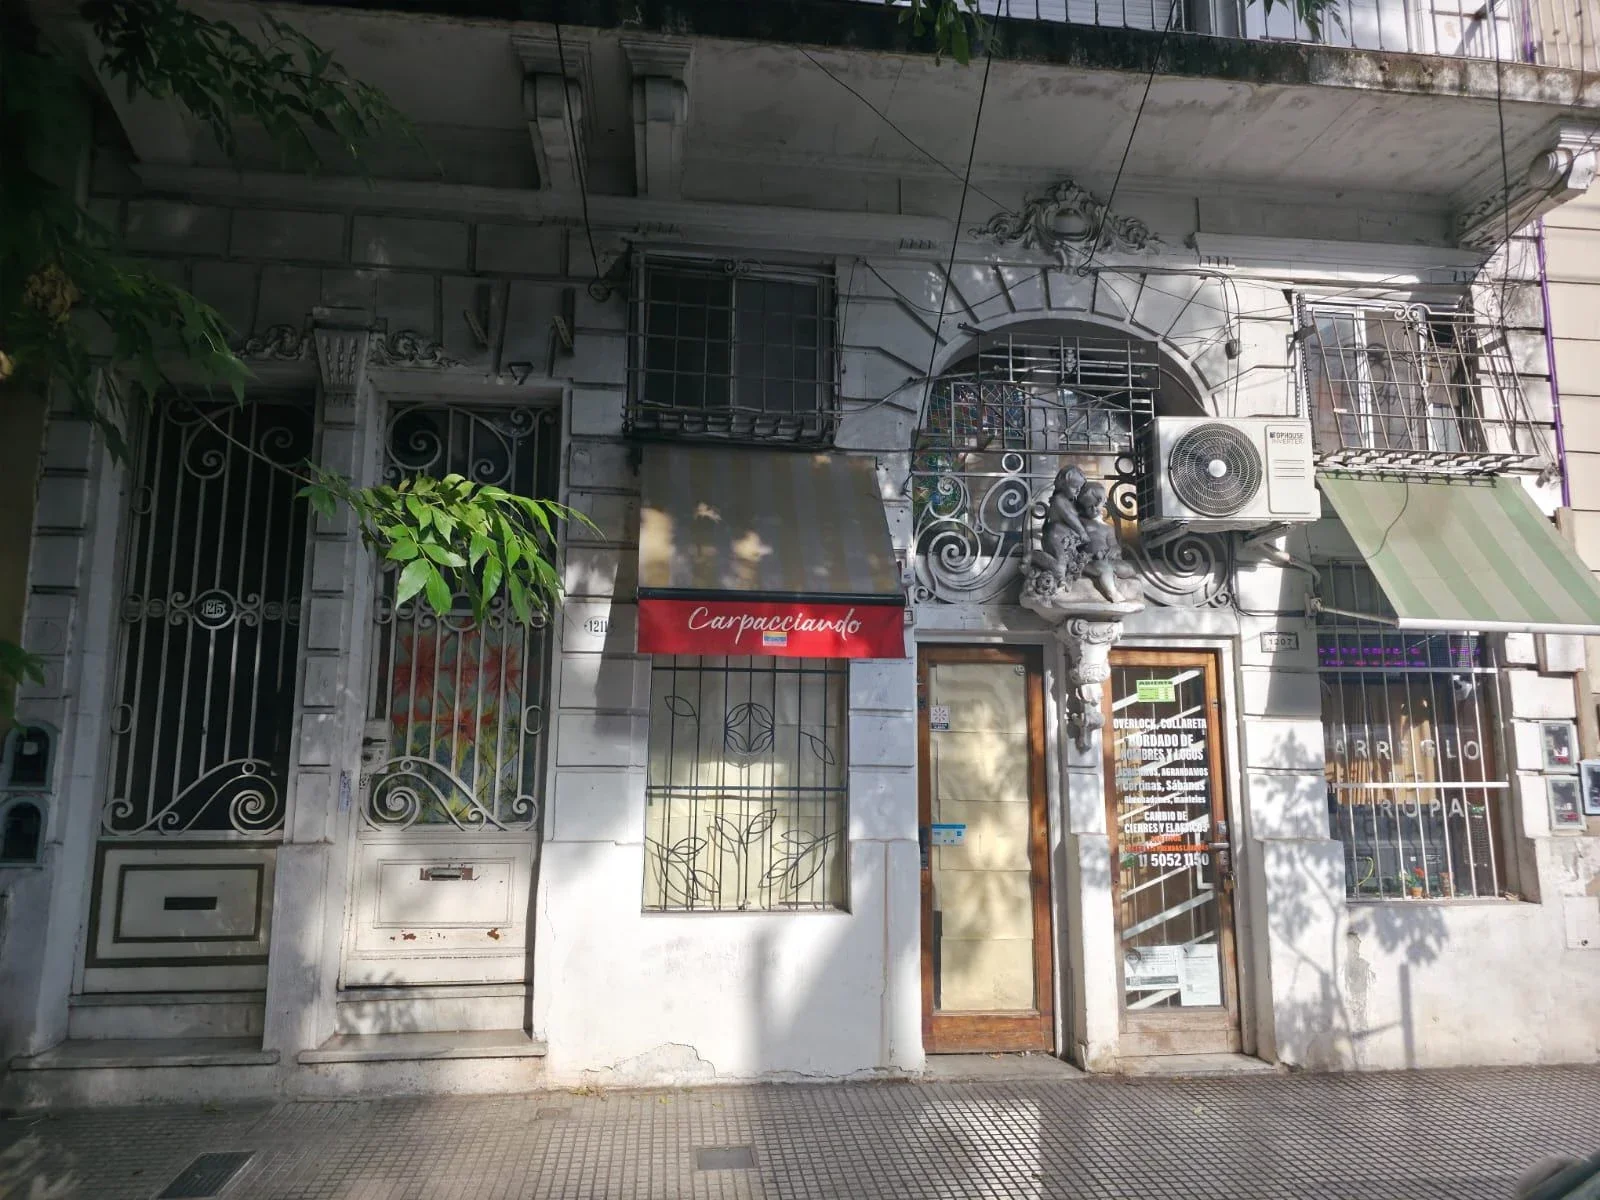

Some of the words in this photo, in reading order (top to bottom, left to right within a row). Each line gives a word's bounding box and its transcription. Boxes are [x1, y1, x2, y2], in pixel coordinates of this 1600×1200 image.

[688, 606, 861, 644] Carpacciando
[1268, 637, 1293, 646] 1207
[1113, 718, 1160, 729] OVERLOCK,
[1161, 718, 1207, 728] COLLARETA
[1128, 734, 1178, 746] BORDADO
[1180, 734, 1194, 746] DE
[1120, 748, 1164, 760] NOMBRES
[1174, 748, 1204, 760] LOGOS
[1335, 739, 1480, 760] ARREGLO
[1162, 768, 1208, 776] AGRANDAMOS
[1123, 780, 1164, 791] Cortinas,
[1166, 780, 1205, 790] Sábanas
[1380, 798, 1465, 818] ROPA
[1144, 811, 1175, 820] CAMBIO
[1176, 811, 1188, 820] DE
[1124, 823, 1158, 832] CIERRES
[1138, 854, 1147, 866] 11
[1151, 854, 1182, 866] 5052
